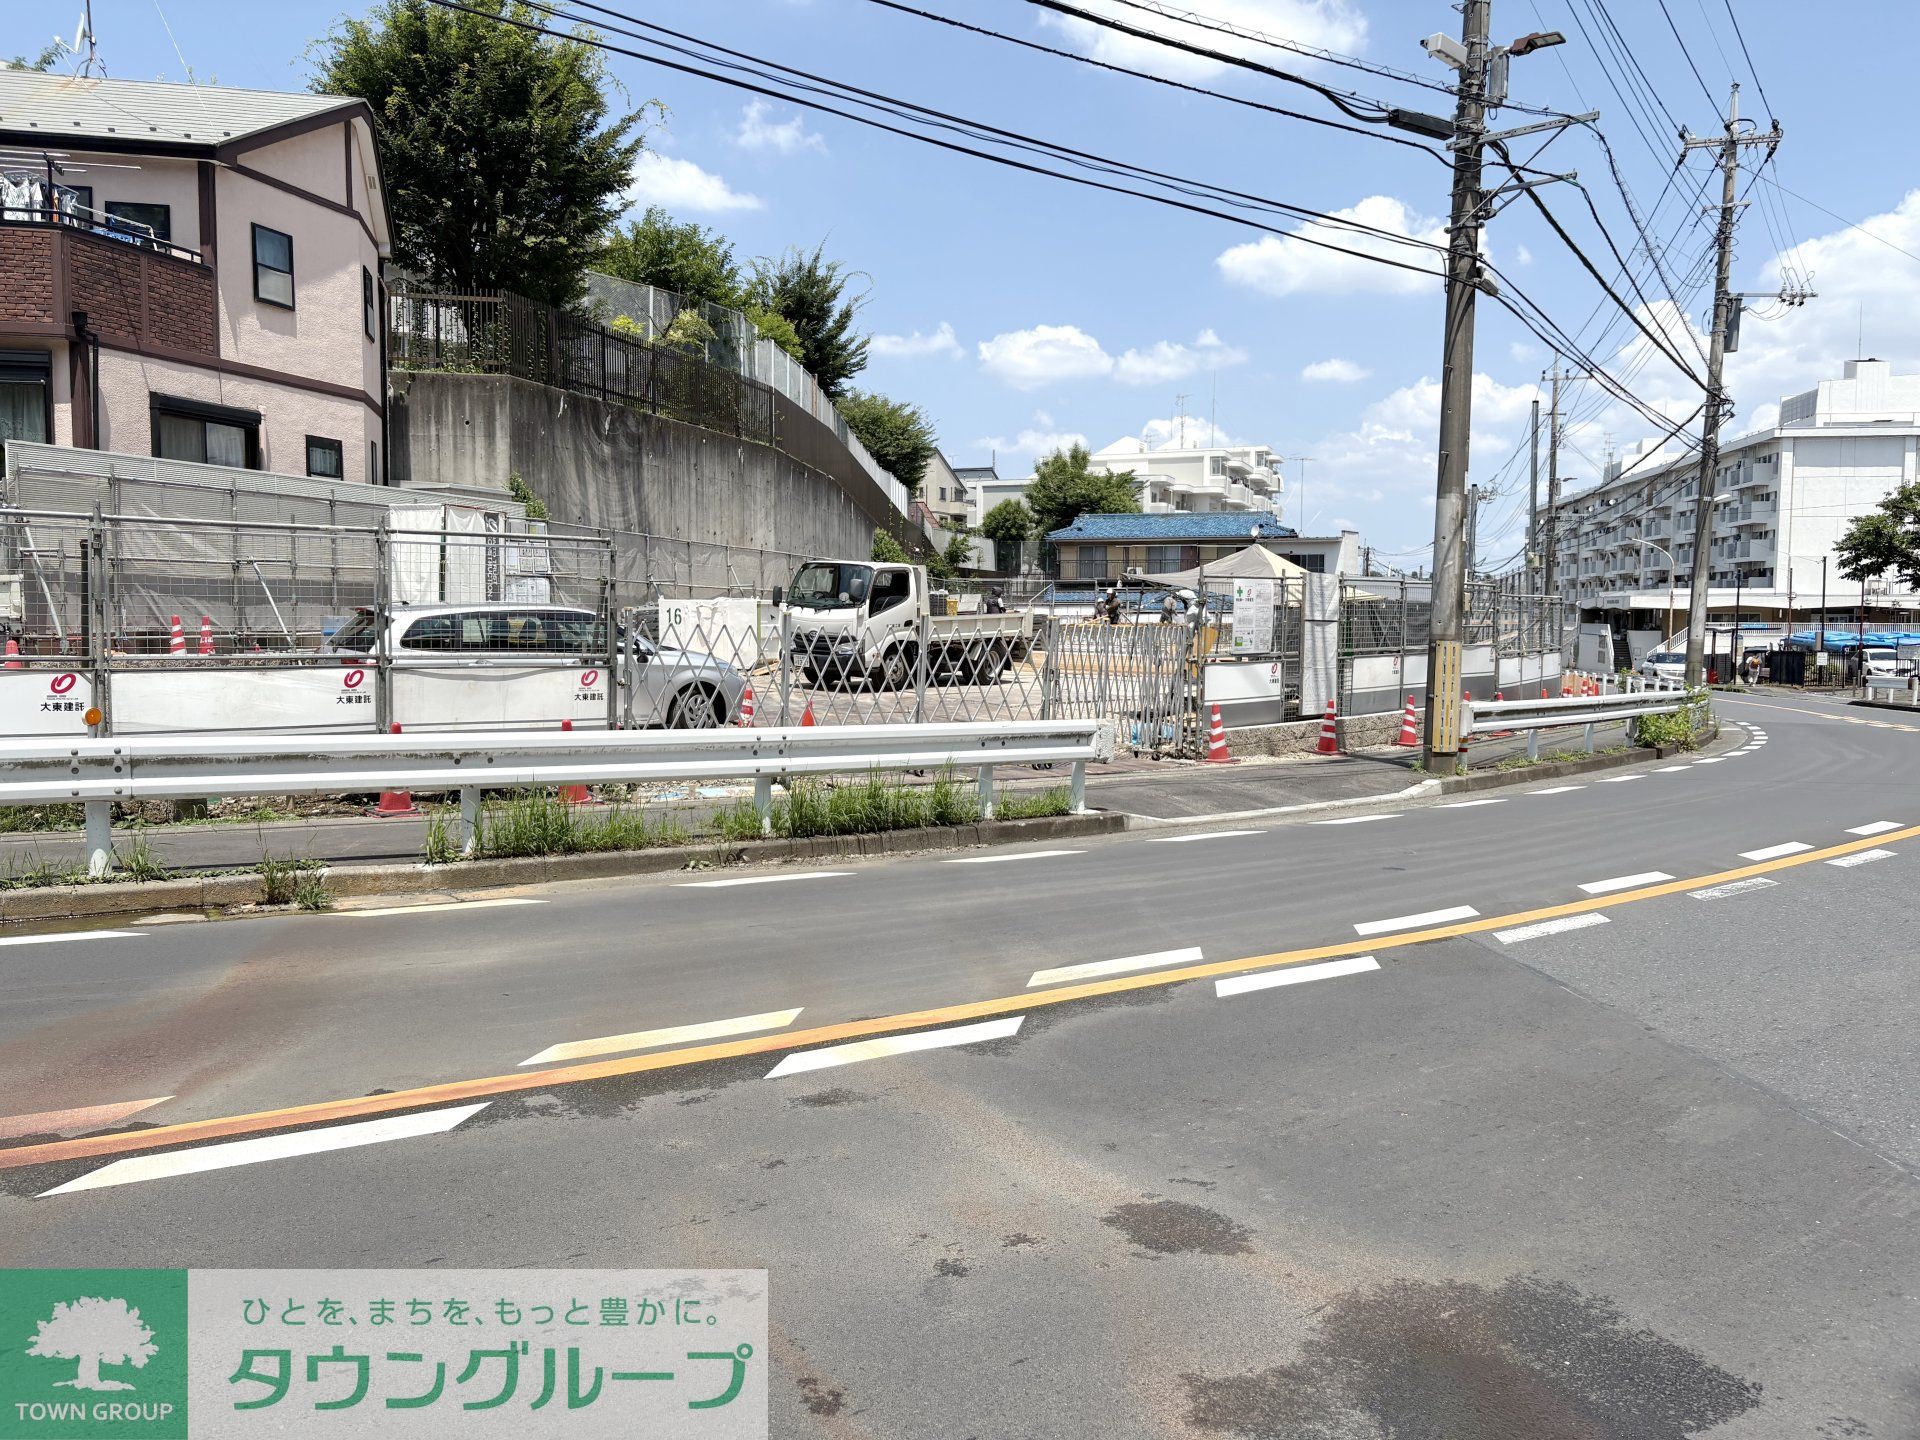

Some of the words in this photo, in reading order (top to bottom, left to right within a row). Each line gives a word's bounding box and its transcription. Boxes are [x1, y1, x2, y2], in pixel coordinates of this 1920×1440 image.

[666, 608, 682, 625] 16
[335, 695, 372, 704] 大東建託
[574, 693, 604, 701] 大東建託
[40, 702, 85, 712] 大東建託
